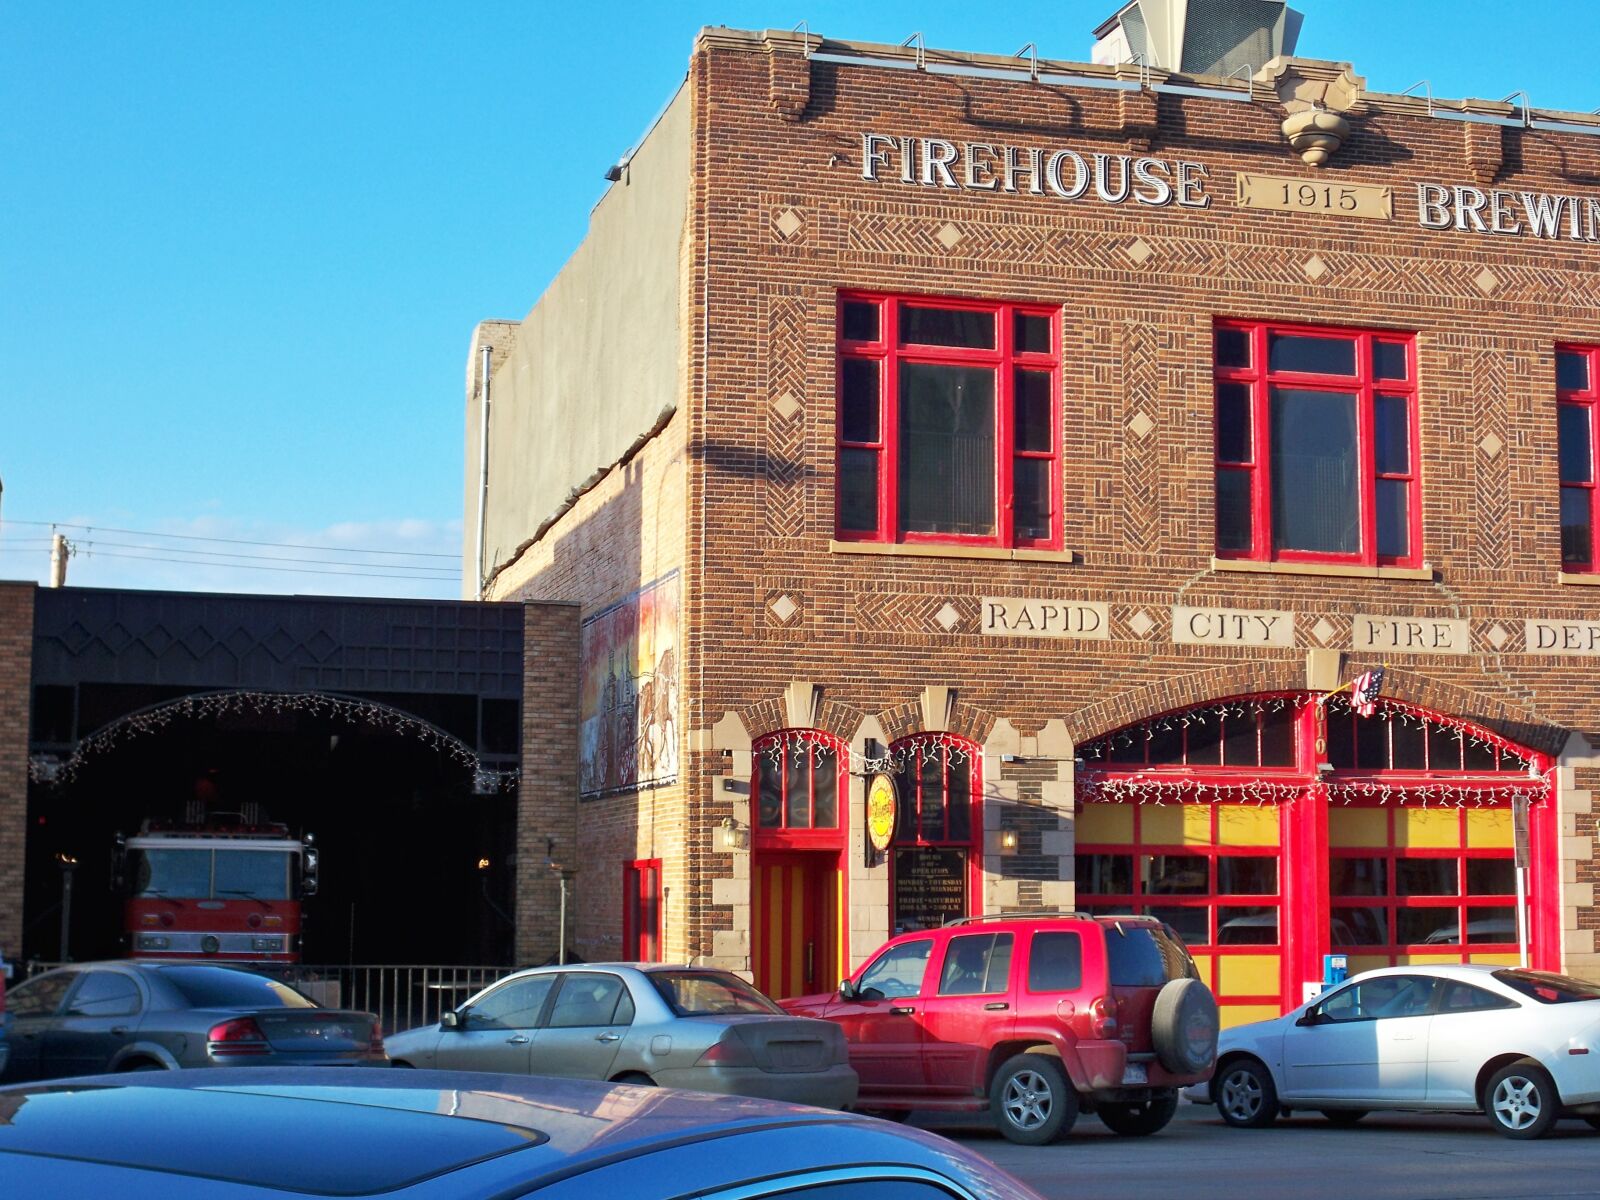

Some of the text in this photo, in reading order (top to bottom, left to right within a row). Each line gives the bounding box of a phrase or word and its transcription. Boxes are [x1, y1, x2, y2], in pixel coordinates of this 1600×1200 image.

[860, 132, 1211, 210] FIREHOUSE
[1281, 183, 1359, 211] 1915
[987, 603, 1600, 650] RAPID CITY FIRE DEP
